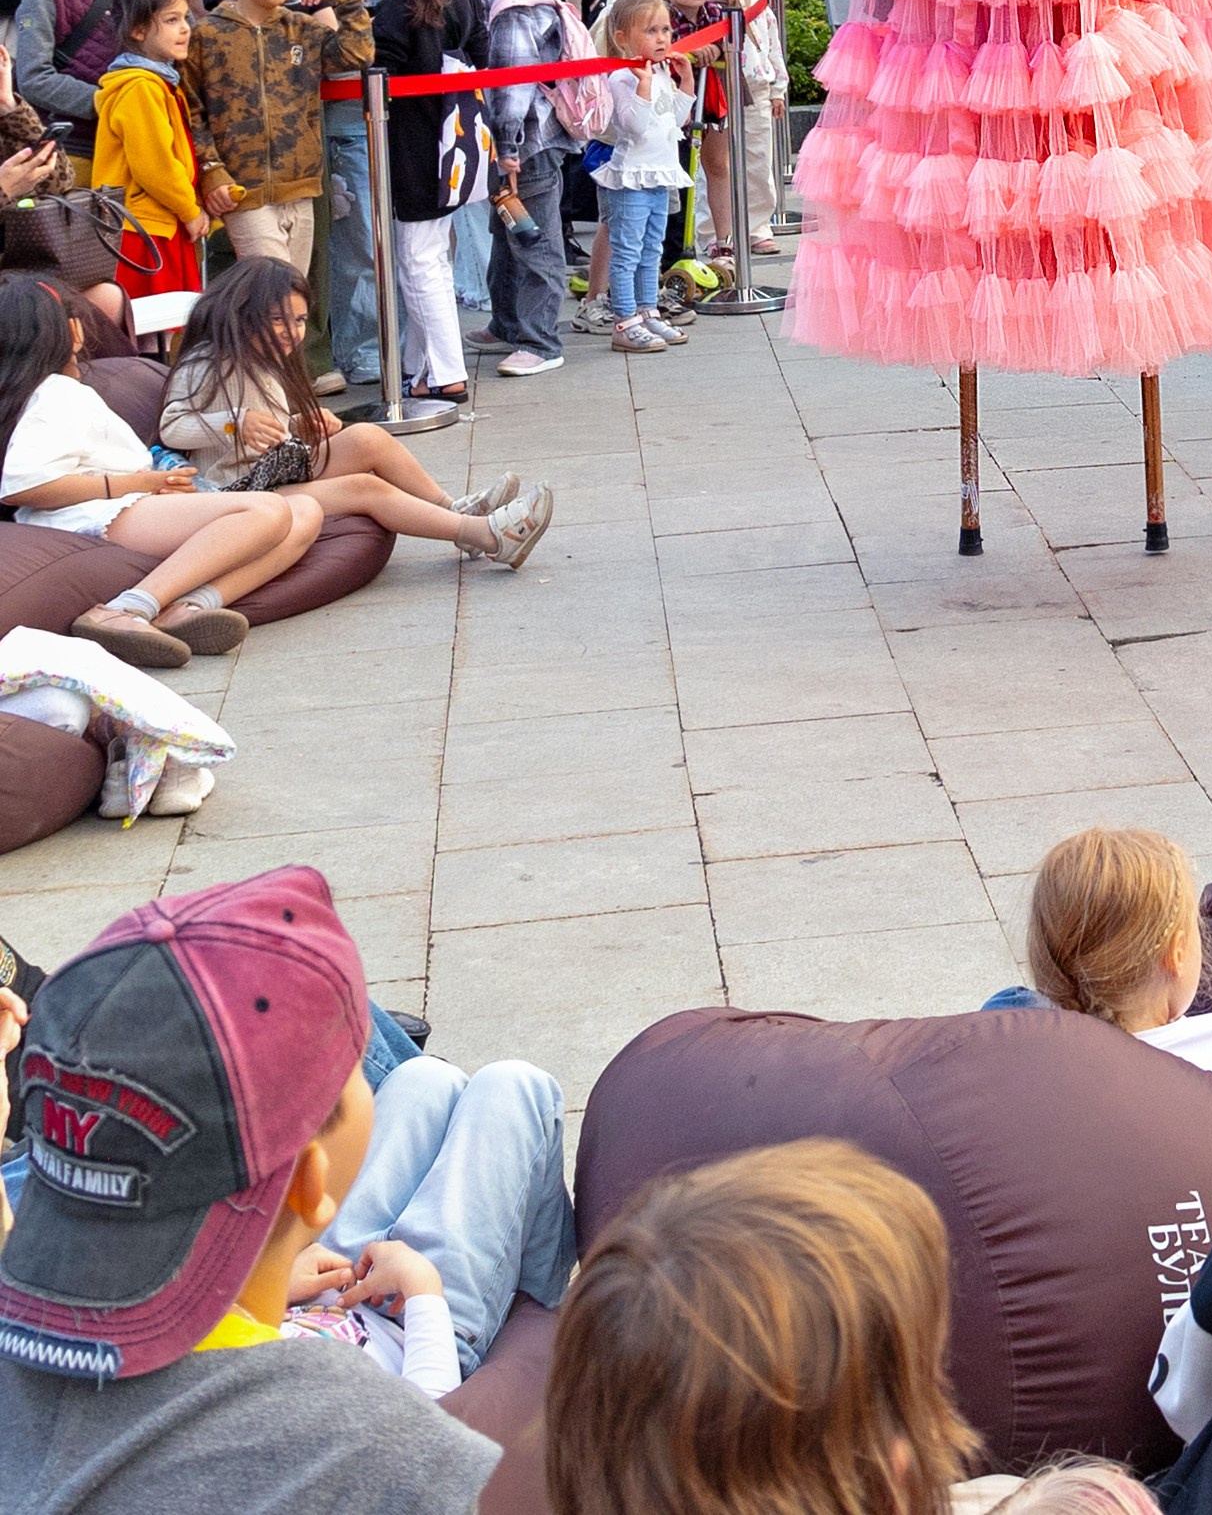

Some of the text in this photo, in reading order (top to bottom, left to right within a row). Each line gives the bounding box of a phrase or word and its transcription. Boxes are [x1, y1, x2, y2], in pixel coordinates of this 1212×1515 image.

[43, 1092, 103, 1157] NY
[1175, 1190, 1211, 1275] ТЕА
[1147, 1223, 1191, 1328] БУЛЬ
